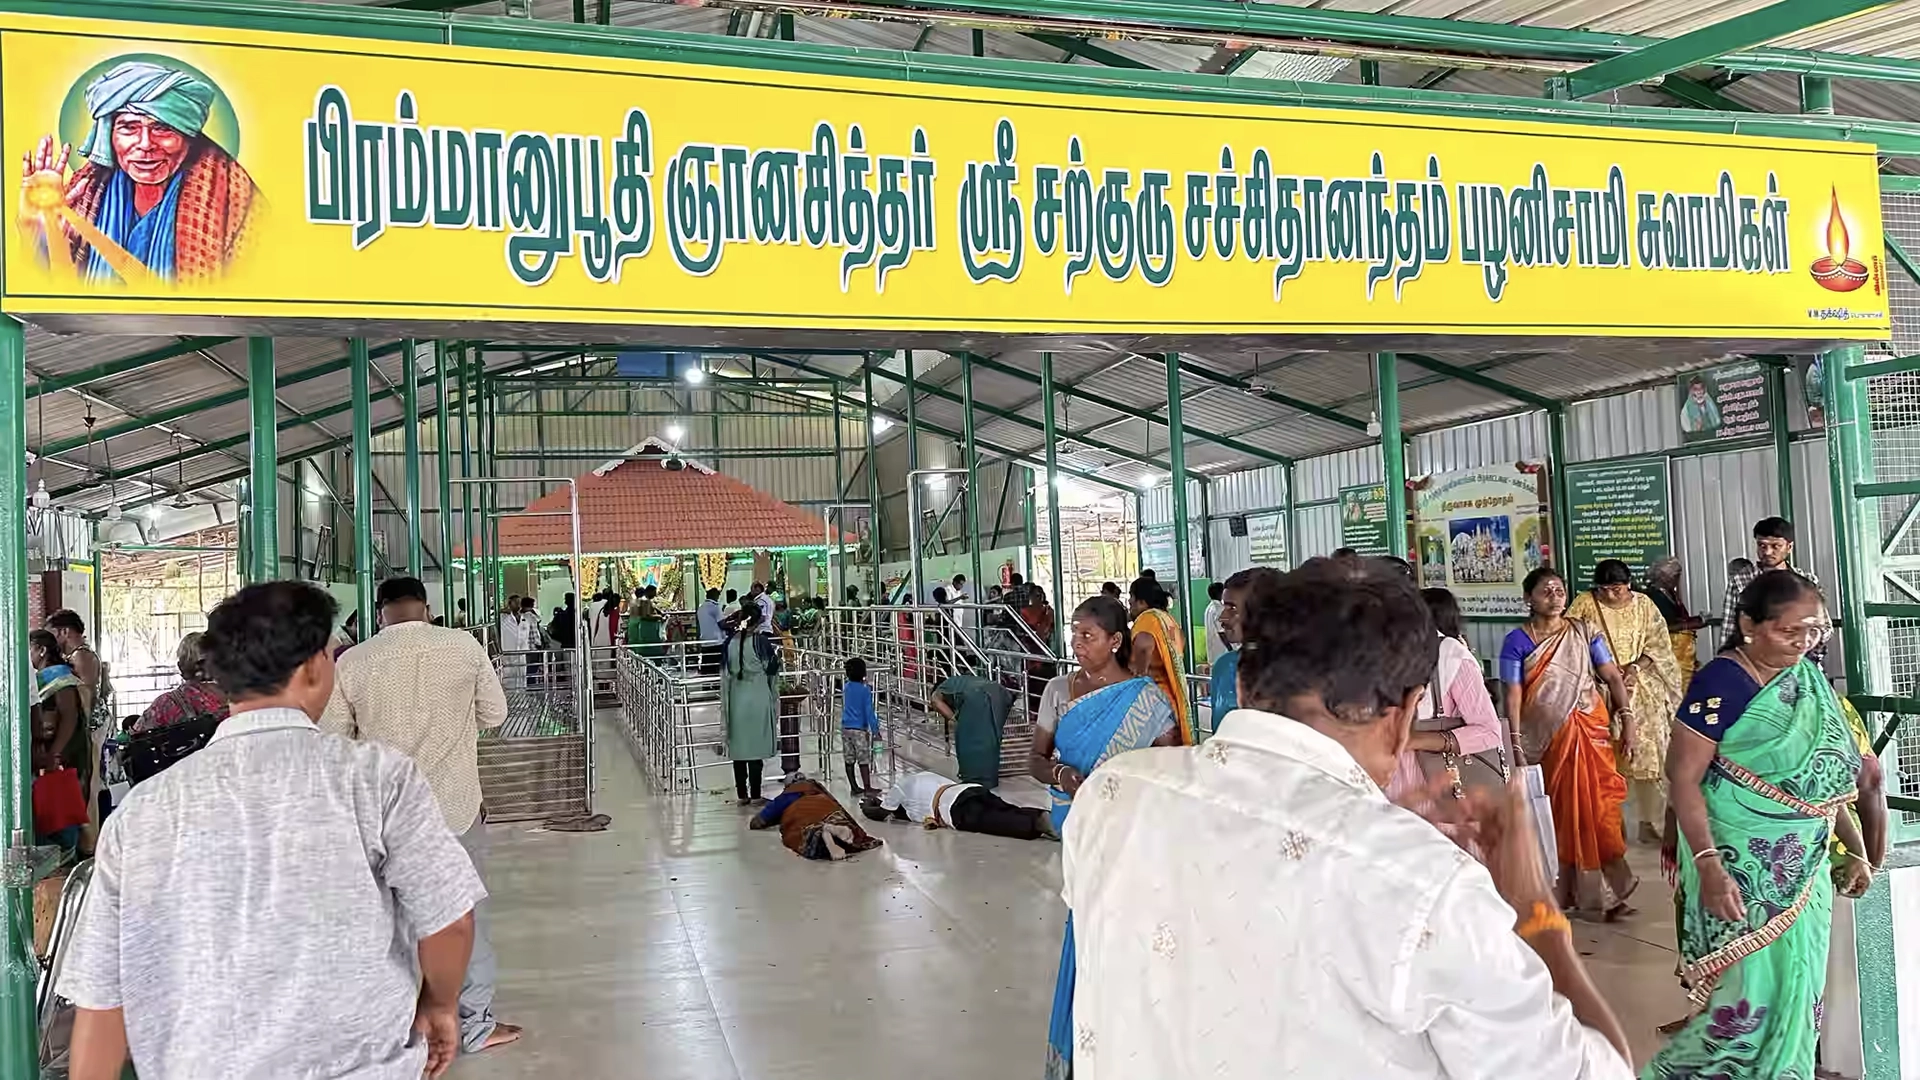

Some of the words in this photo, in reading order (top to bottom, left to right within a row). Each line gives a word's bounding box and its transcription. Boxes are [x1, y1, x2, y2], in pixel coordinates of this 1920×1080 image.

[306, 86, 652, 284] பிரம்மானுபூதி
[666, 122, 935, 291] ஞானசித்தர்
[959, 118, 1023, 282] ஸ்ரீ
[1033, 136, 1175, 292] சற்குரு
[1184, 145, 1451, 299] சச்சிதானந்தம்
[1457, 162, 1630, 301] பழனிசாமி
[1636, 170, 1789, 273] சுவாமிகள்
